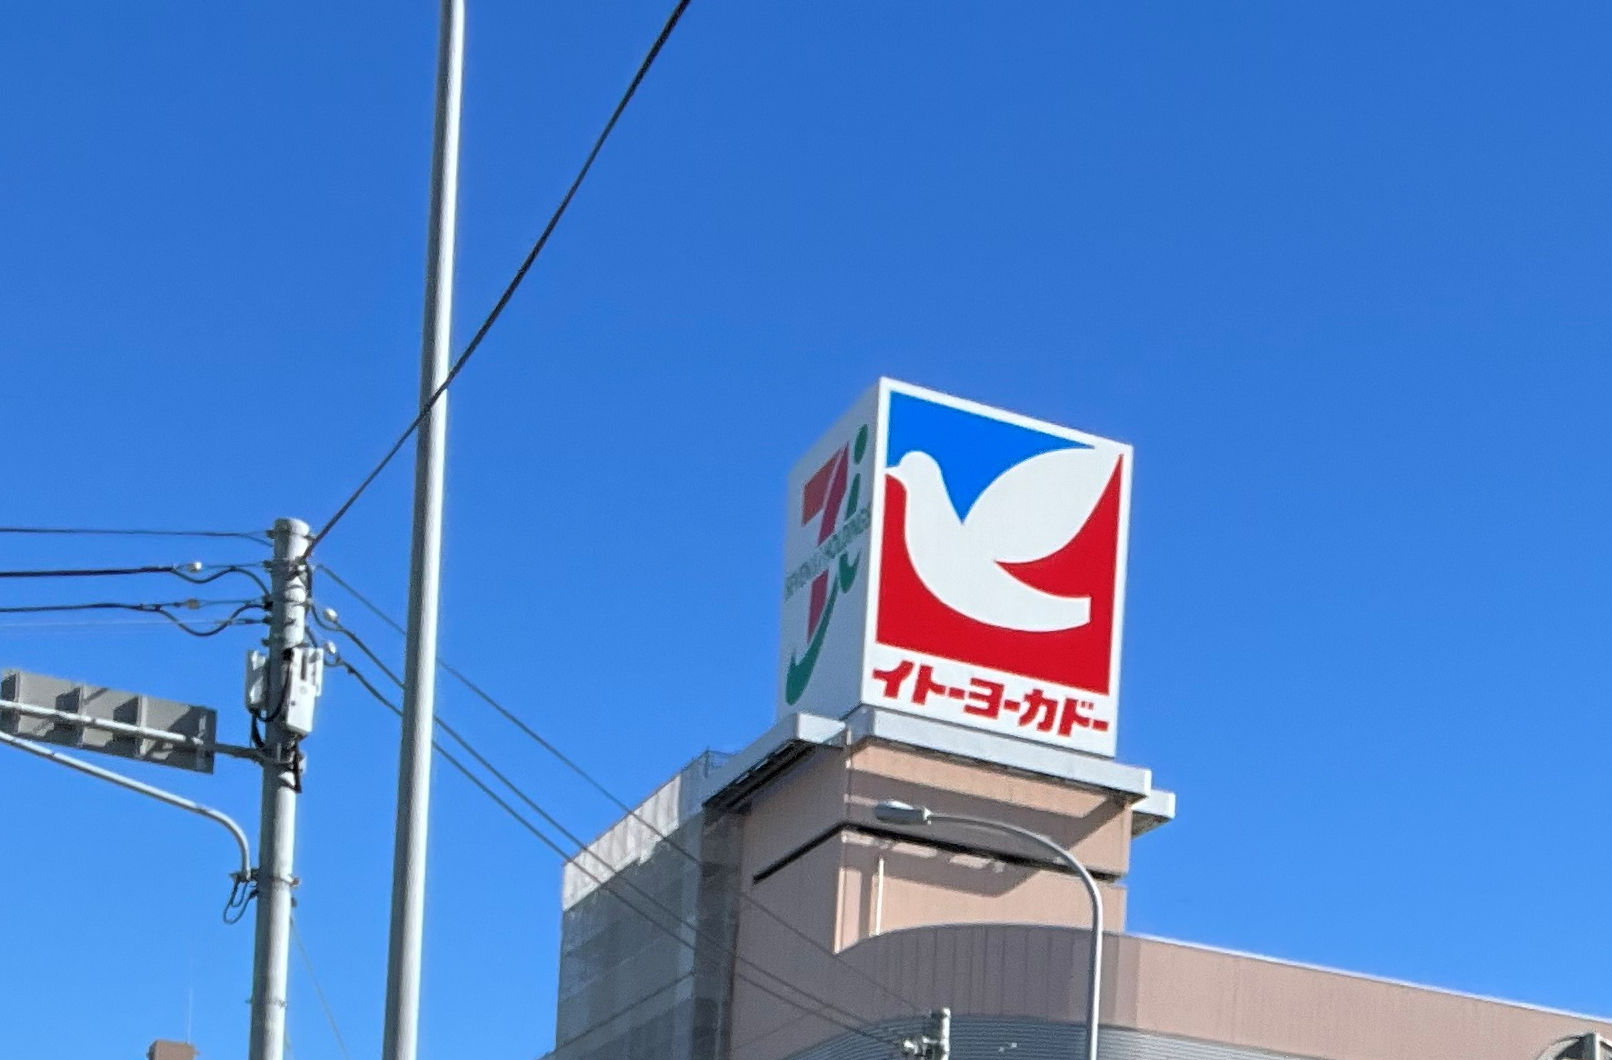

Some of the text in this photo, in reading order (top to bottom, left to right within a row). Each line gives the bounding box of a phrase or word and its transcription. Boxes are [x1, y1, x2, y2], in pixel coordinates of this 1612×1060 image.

[872, 660, 1109, 737] イトーヨーカドー
